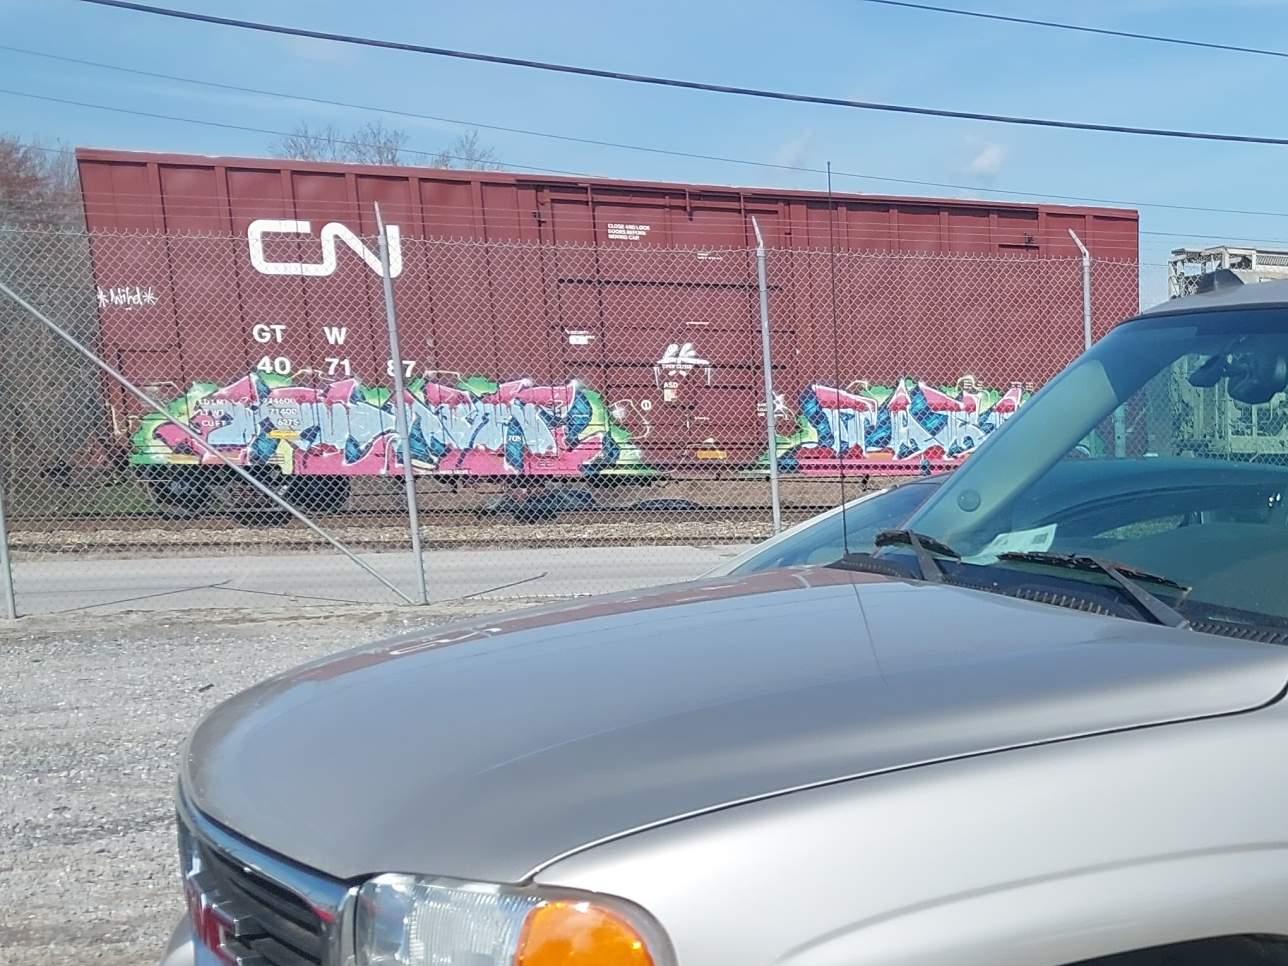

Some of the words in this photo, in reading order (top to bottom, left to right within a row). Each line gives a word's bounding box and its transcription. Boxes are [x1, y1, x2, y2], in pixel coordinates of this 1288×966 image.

[247, 219, 403, 278] CN
[252, 324, 286, 343] GT
[324, 327, 347, 345] W
[257, 356, 291, 374] 40
[325, 358, 351, 376] 71
